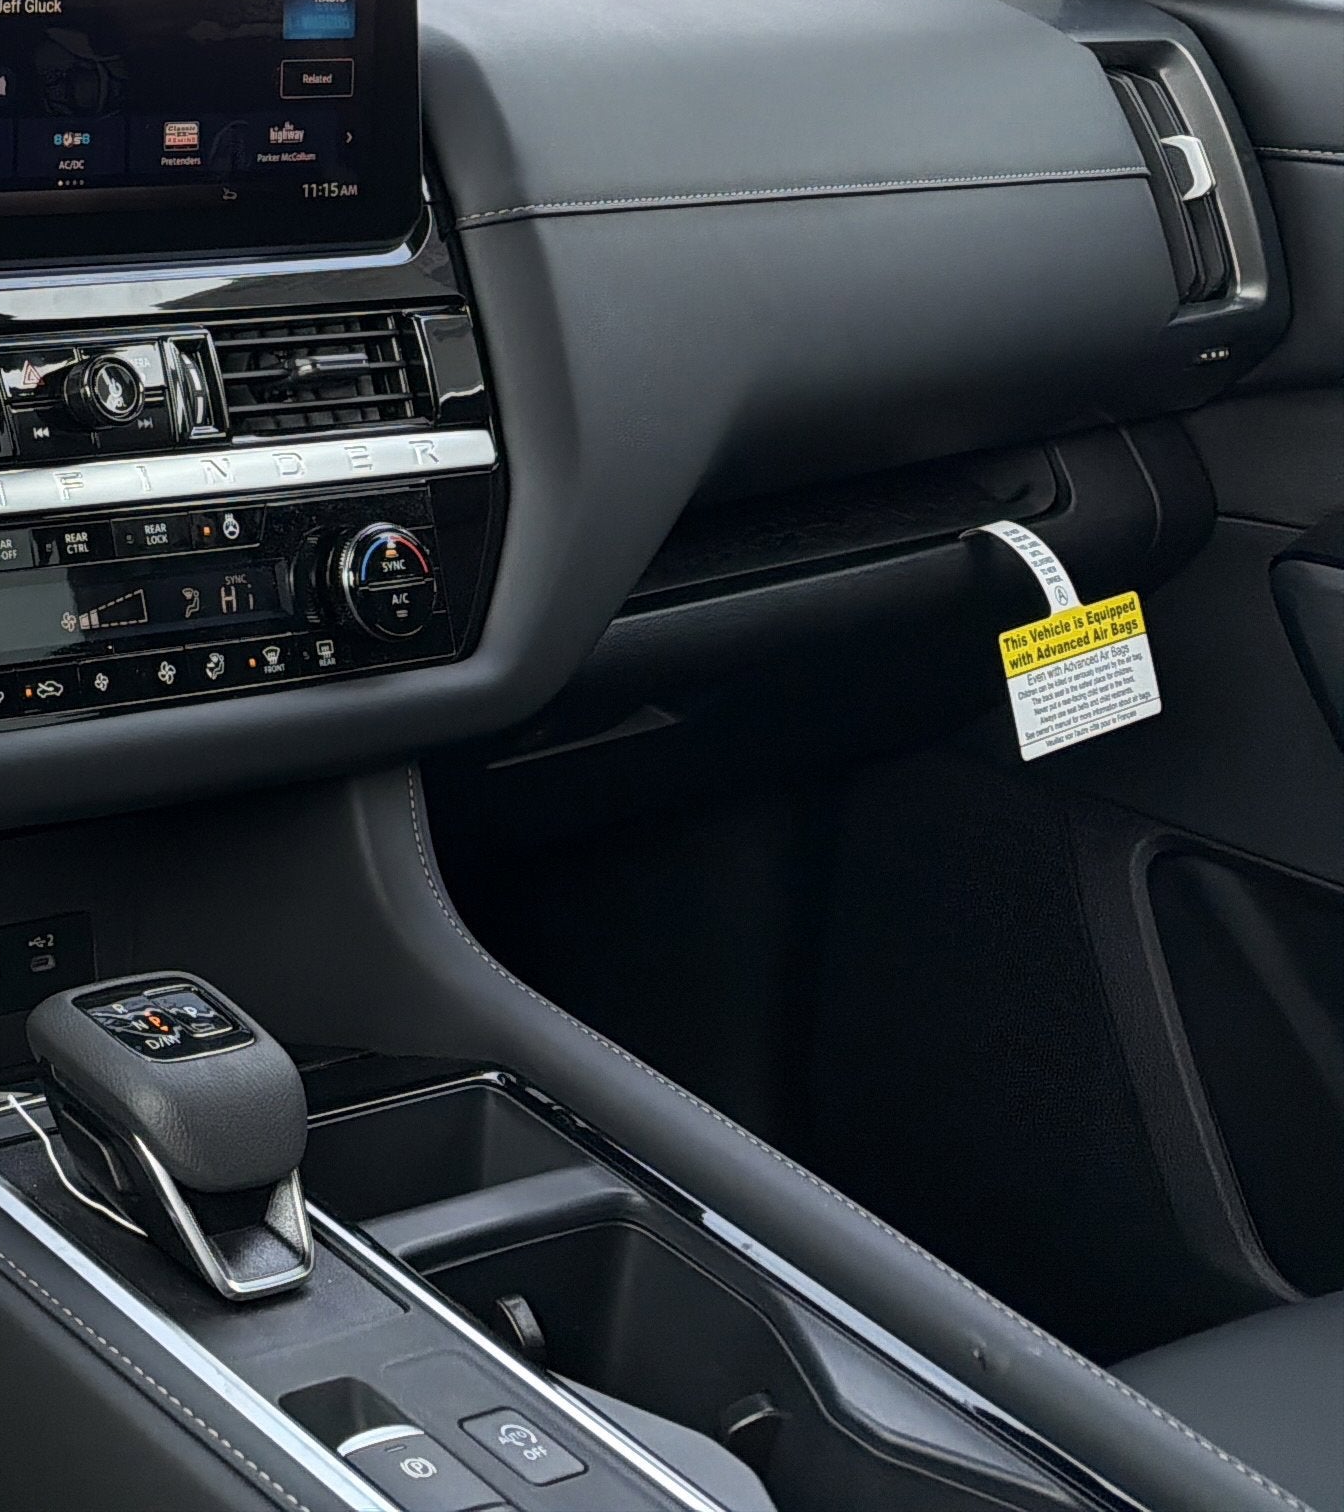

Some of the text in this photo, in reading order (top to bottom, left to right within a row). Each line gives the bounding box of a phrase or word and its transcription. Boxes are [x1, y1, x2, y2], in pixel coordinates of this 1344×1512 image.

[302, 74, 332, 84] Related
[161, 156, 201, 166] Pretenders
[257, 154, 280, 162] Parker
[58, 160, 84, 170] AC/DC
[302, 183, 358, 197] 11:15 AM
[144, 523, 167, 535] REAR
[65, 532, 88, 543] REAR
[146, 533, 168, 546] LOCK
[67, 542, 89, 554] CTRL
[382, 559, 406, 572] SYNC
[225, 574, 248, 585] SYNC
[392, 592, 410, 605] A/C
[1004, 597, 1136, 652] This Vehicle is Equipped
[1009, 618, 1138, 670] with Advanced Air Bags
[319, 657, 336, 666] REAR
[1027, 644, 1129, 686] Even with Advanced Air Bags
[264, 664, 285, 674] FRONT
[112, 1003, 128, 1014] R
[183, 1006, 198, 1018] P
[131, 1019, 149, 1030] N
[498, 1430, 528, 1445] AUTO
[523, 1445, 548, 1460] OFF
